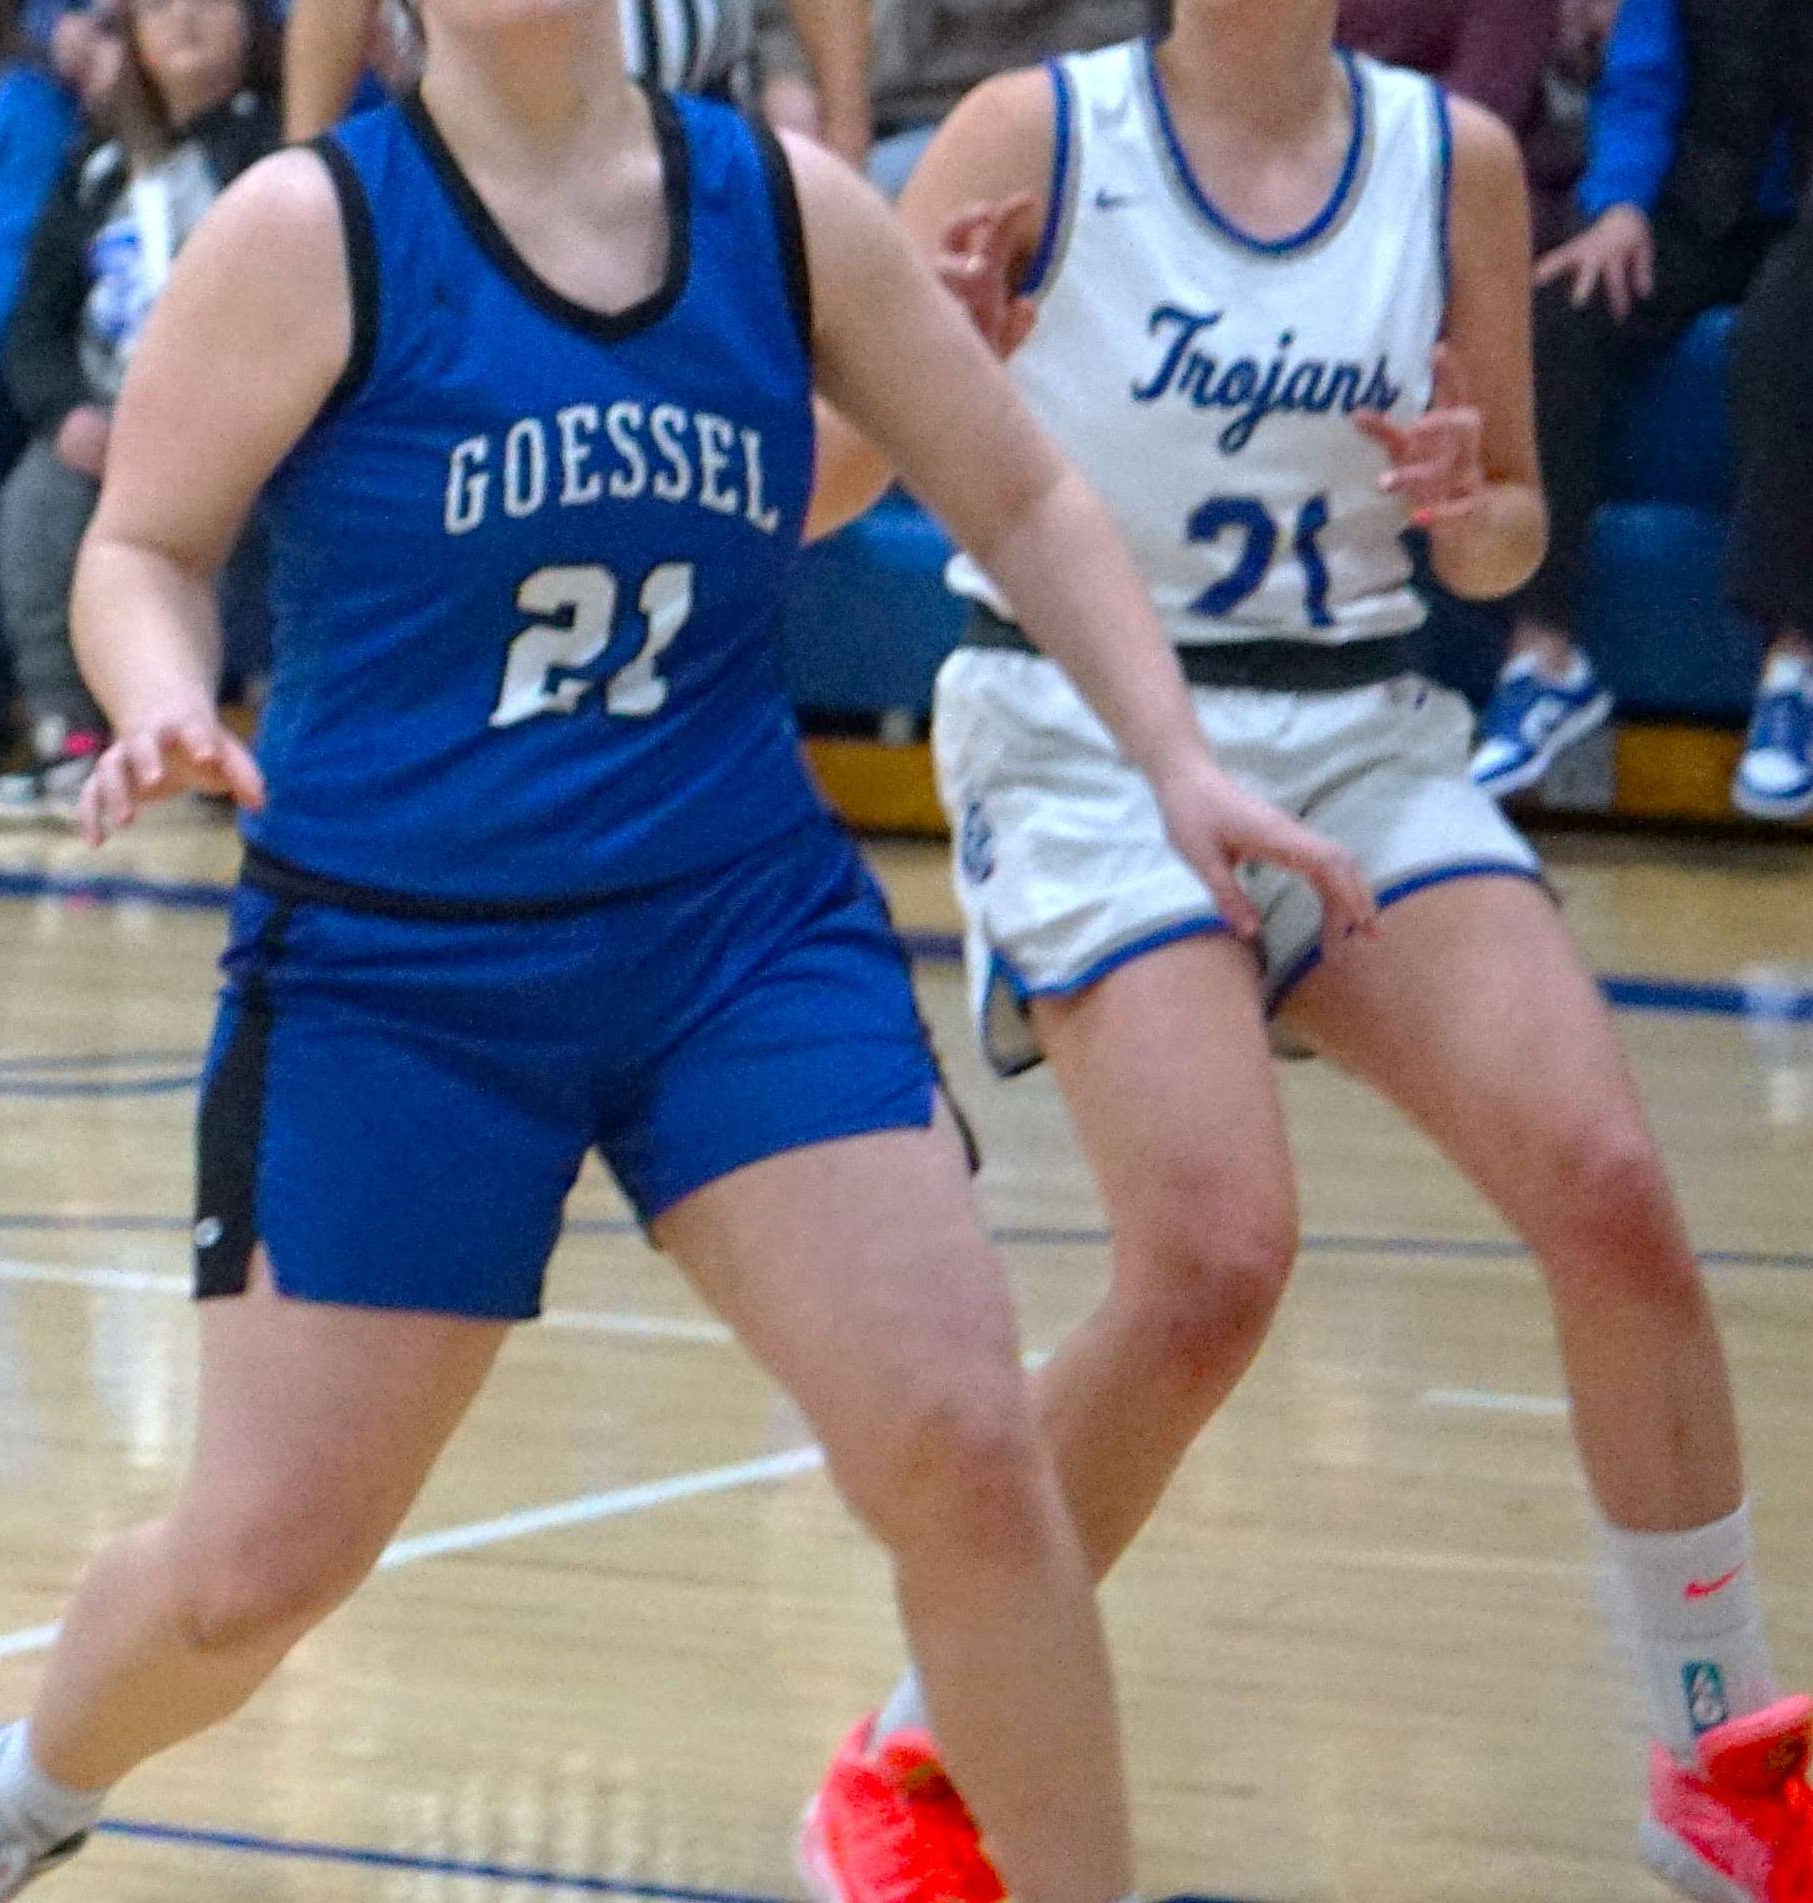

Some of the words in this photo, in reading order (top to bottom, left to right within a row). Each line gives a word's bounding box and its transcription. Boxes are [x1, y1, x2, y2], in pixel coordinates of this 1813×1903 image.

[1132, 301, 1402, 453] Trojans
[444, 402, 779, 535] GOESSEL
[1185, 491, 1333, 627] 21
[488, 561, 695, 728] 21
